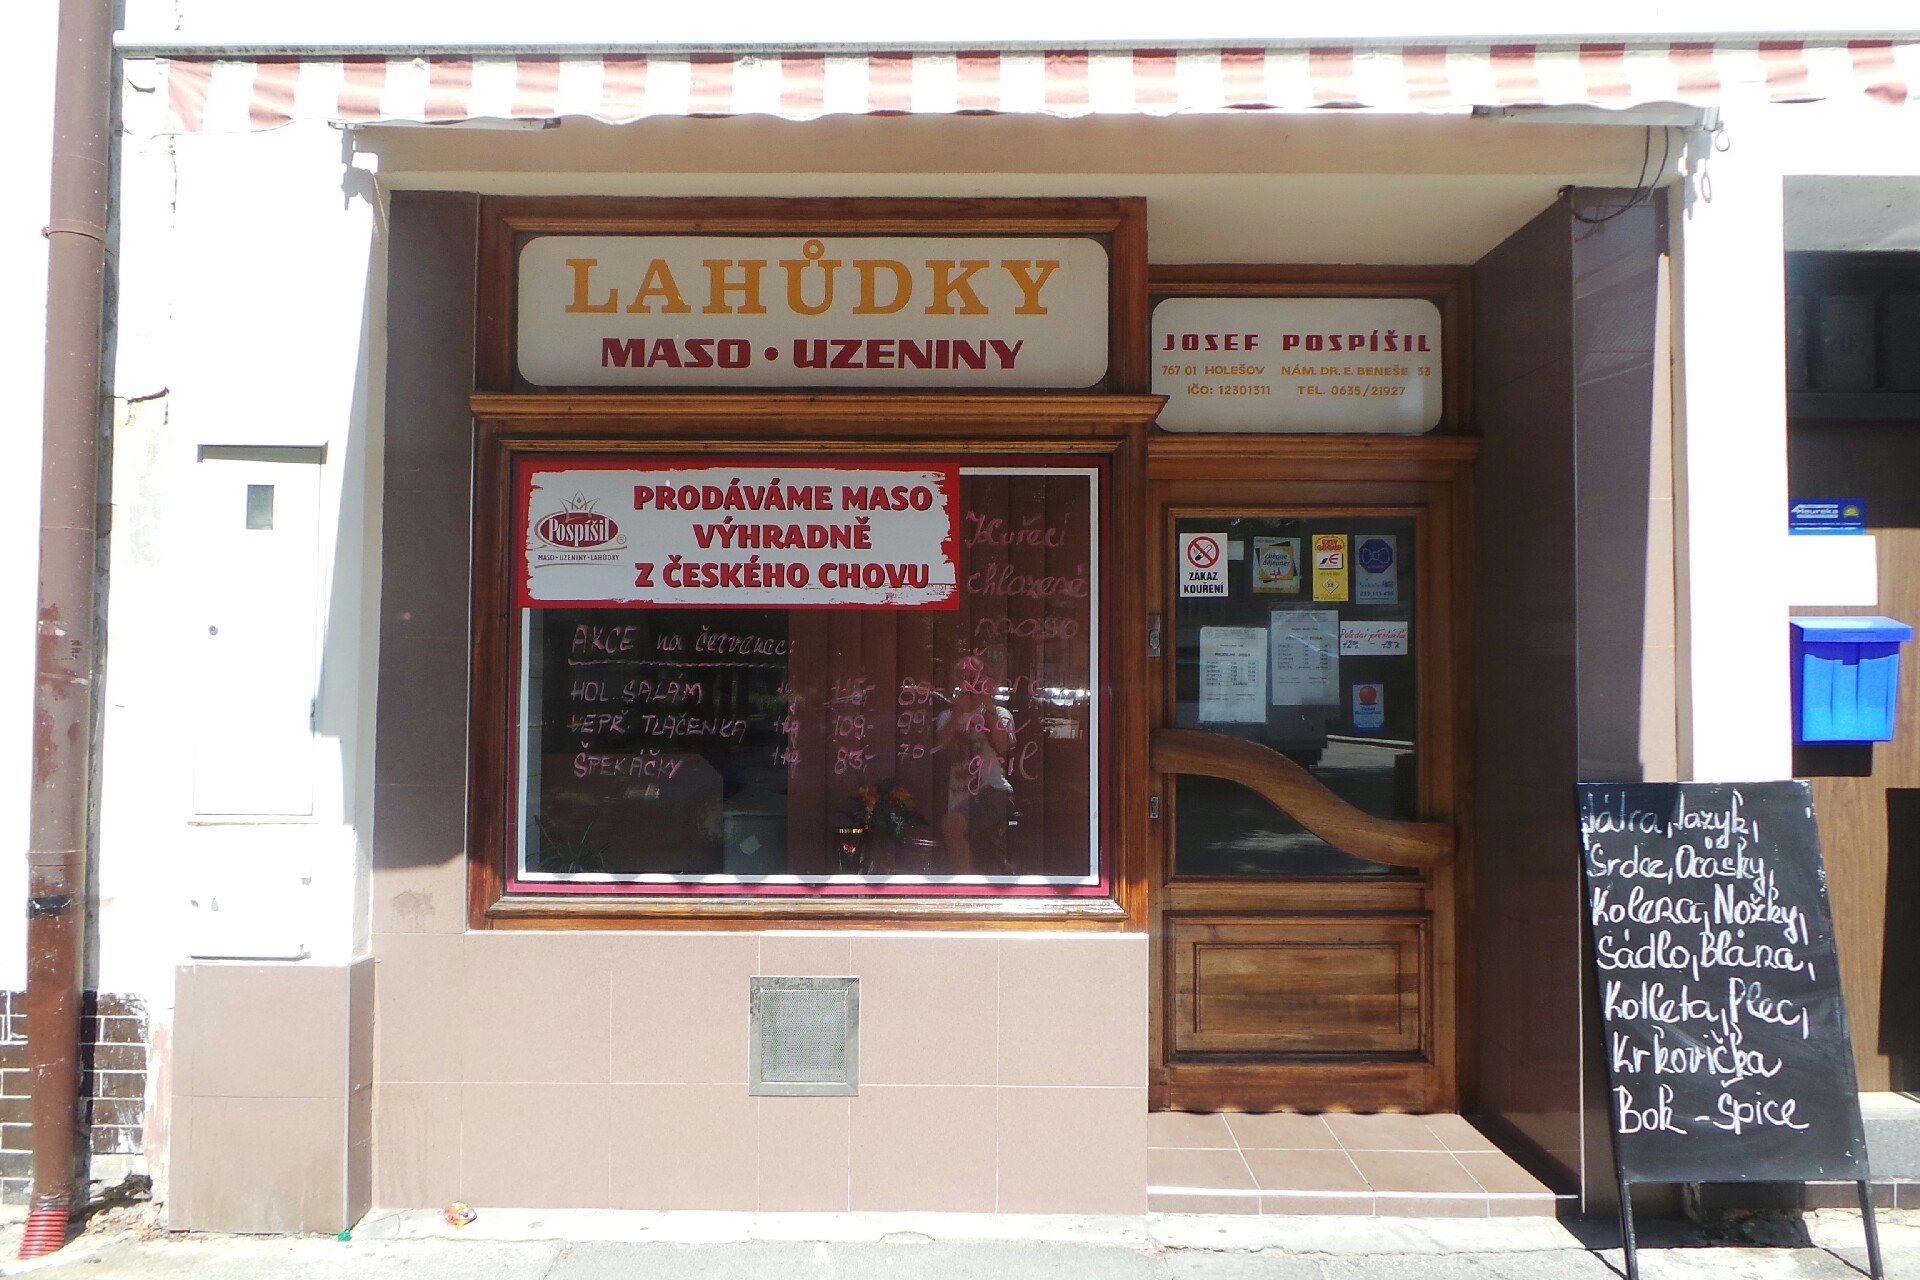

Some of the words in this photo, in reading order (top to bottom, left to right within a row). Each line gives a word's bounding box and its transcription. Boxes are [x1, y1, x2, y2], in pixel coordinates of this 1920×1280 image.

[565, 239, 1060, 315] LAHŮDKY
[601, 338, 751, 369] MASO
[793, 340, 1025, 370] UZENINY
[1163, 333, 1259, 352] JOSEF
[1283, 329, 1431, 352] POSPÍŠIL
[1162, 365, 1180, 376] 767
[1185, 365, 1197, 376] 01
[1205, 363, 1265, 376] HOLEŠOV
[1357, 364, 1409, 377] BENEŠE
[1187, 382, 1213, 395] IČO:
[1219, 385, 1271, 396] 12301311
[1298, 385, 1326, 396] TEL.
[633, 477, 833, 511] PRODÁVÁME
[842, 486, 933, 511] MASO
[548, 518, 609, 547] Pospíšil
[692, 516, 872, 549] VÝHRADNĚ
[590, 553, 620, 561] LAHŮDKY
[634, 563, 655, 588] Z
[662, 554, 810, 588] ČESKÉHO
[818, 563, 930, 588] CHOVU
[1183, 581, 1224, 594] KOUŘENÍ
[1189, 569, 1218, 580] ZÁKAZ
[572, 625, 639, 654] AKCE
[622, 673, 704, 705] SALÁM
[642, 713, 747, 743] TLAČENKA
[573, 740, 684, 779] ŠPEKÁČKY
[1612, 1083, 1688, 1135] Bok
